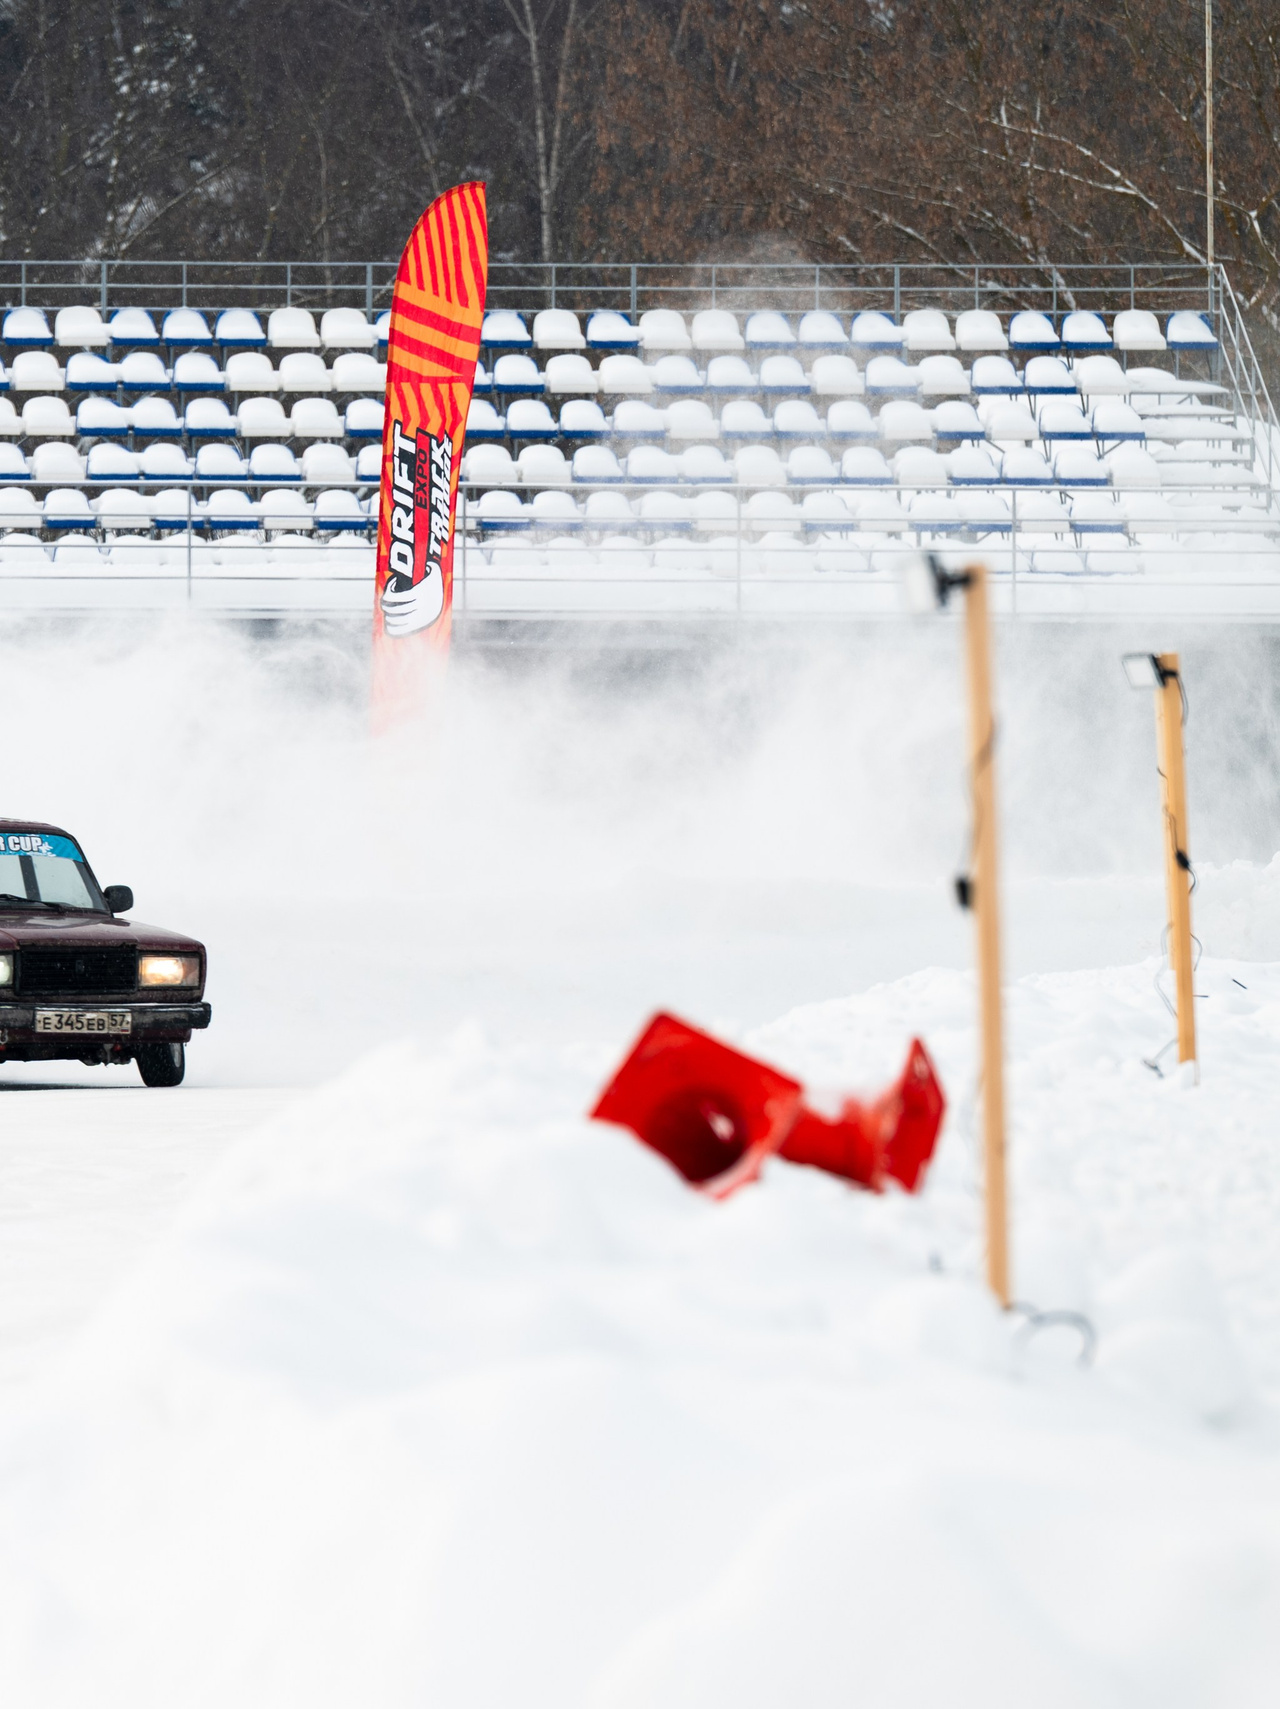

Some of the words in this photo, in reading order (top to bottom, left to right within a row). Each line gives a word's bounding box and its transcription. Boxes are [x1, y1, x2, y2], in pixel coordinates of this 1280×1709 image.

[389, 422, 417, 578] DRIFT
[415, 448, 428, 510] EXPO
[430, 437, 445, 557] TRACK
[8, 835, 43, 852] CUP
